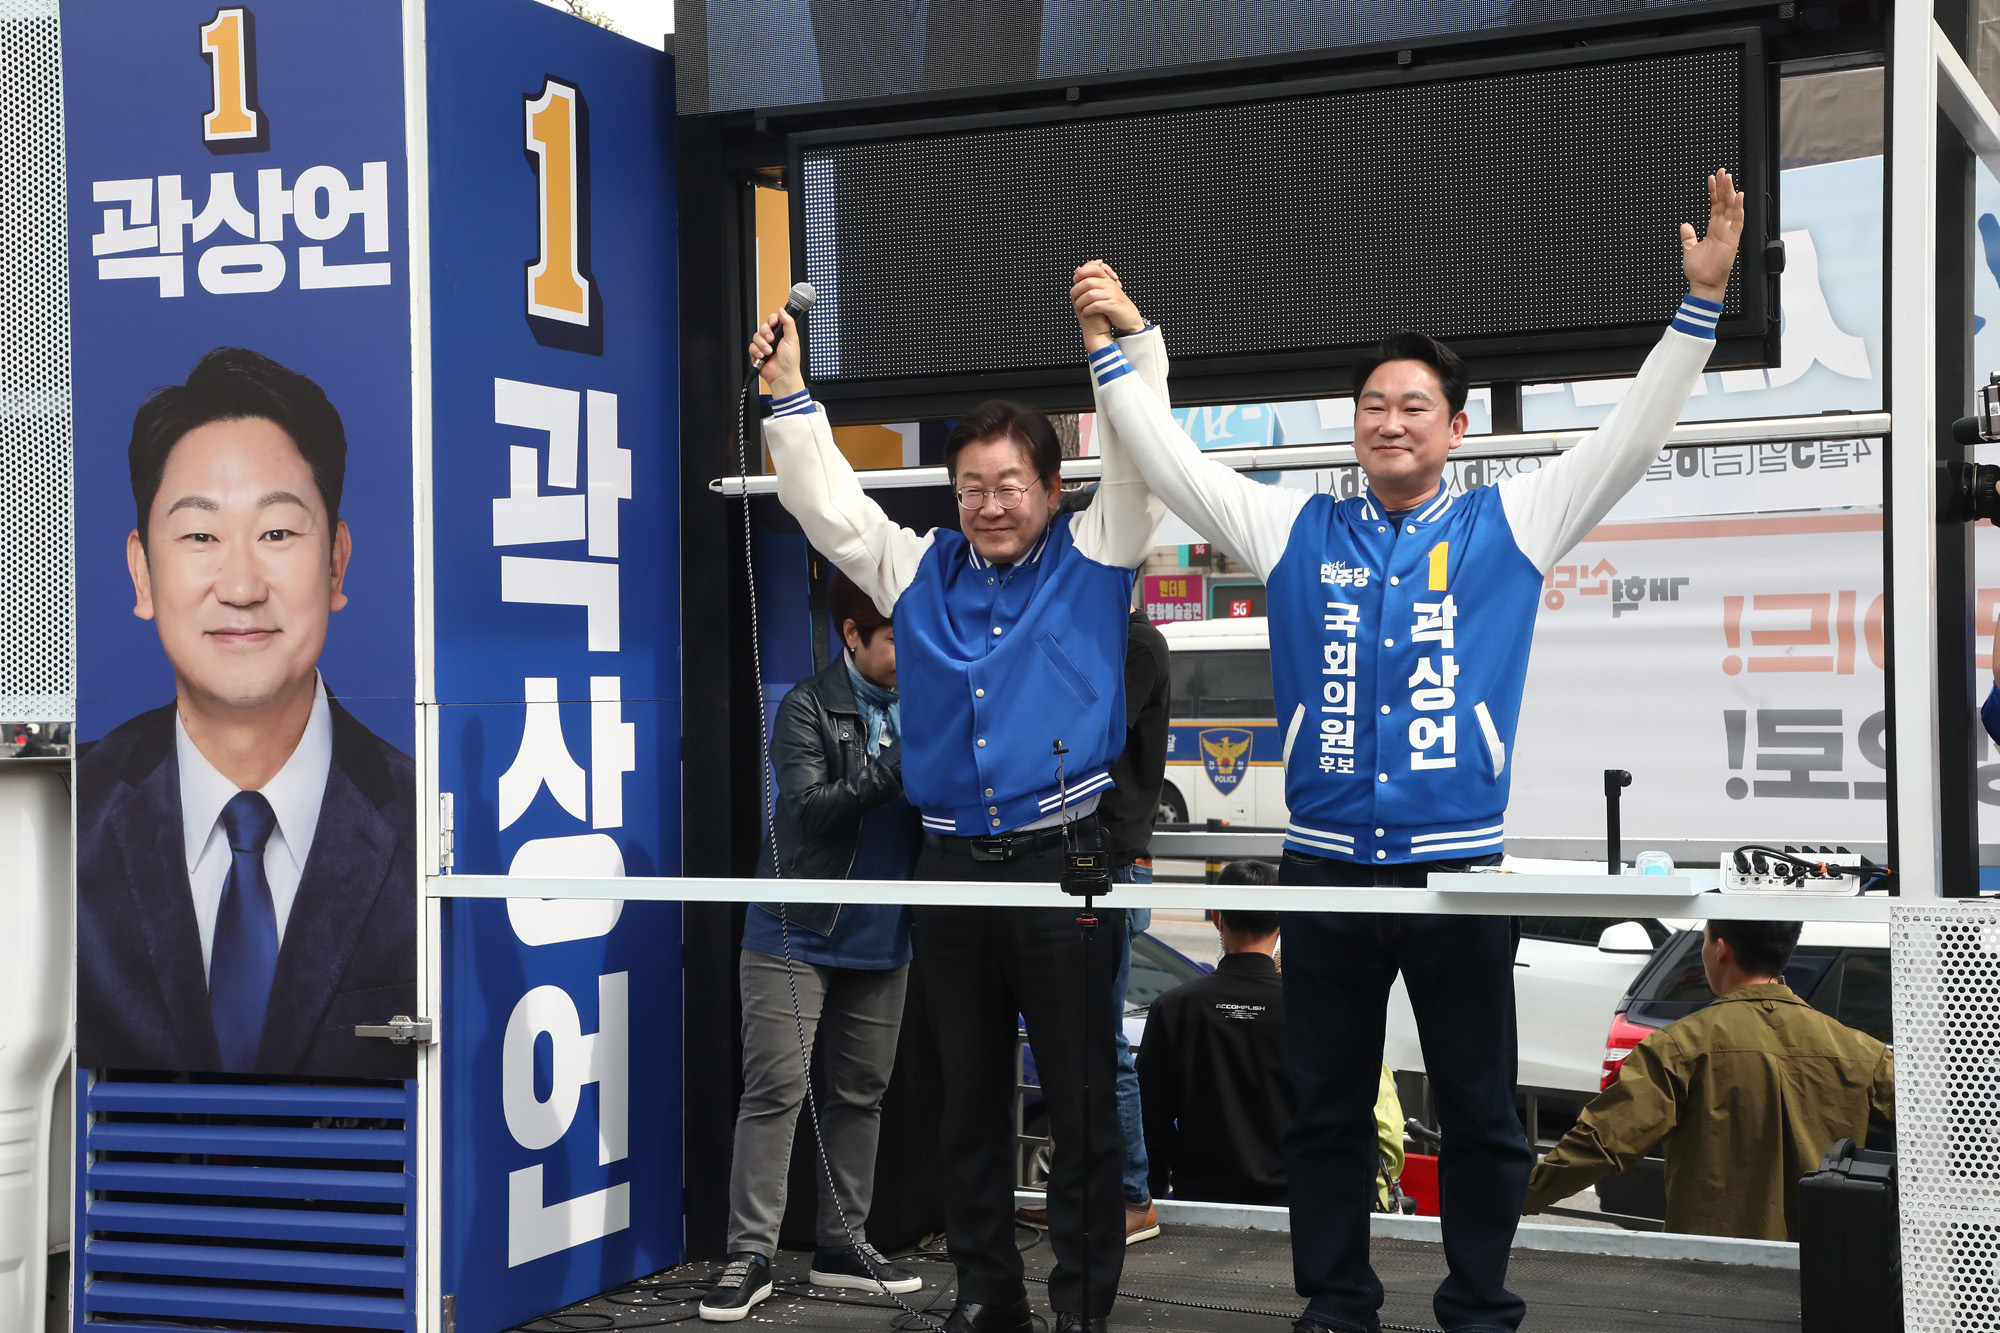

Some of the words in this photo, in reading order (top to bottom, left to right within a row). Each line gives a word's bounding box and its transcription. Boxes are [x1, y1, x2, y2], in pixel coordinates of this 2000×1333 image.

[201, 8, 258, 141] 1
[525, 80, 590, 327] 1
[92, 161, 391, 298] 곽상언
[1195, 544, 1205, 554] 5G
[1427, 541, 1450, 592] 1
[1320, 563, 1371, 588] 민주당
[1232, 602, 1247, 616] 5G
[1318, 601, 1361, 755] 국회의원
[1408, 594, 1460, 771] 곽상언
[1214, 775, 1237, 784] POLICE
[1318, 755, 1356, 774] 후보
[492, 377, 636, 1268] 곽상언
[1215, 1003, 1266, 1011] ACCOMPLISH
